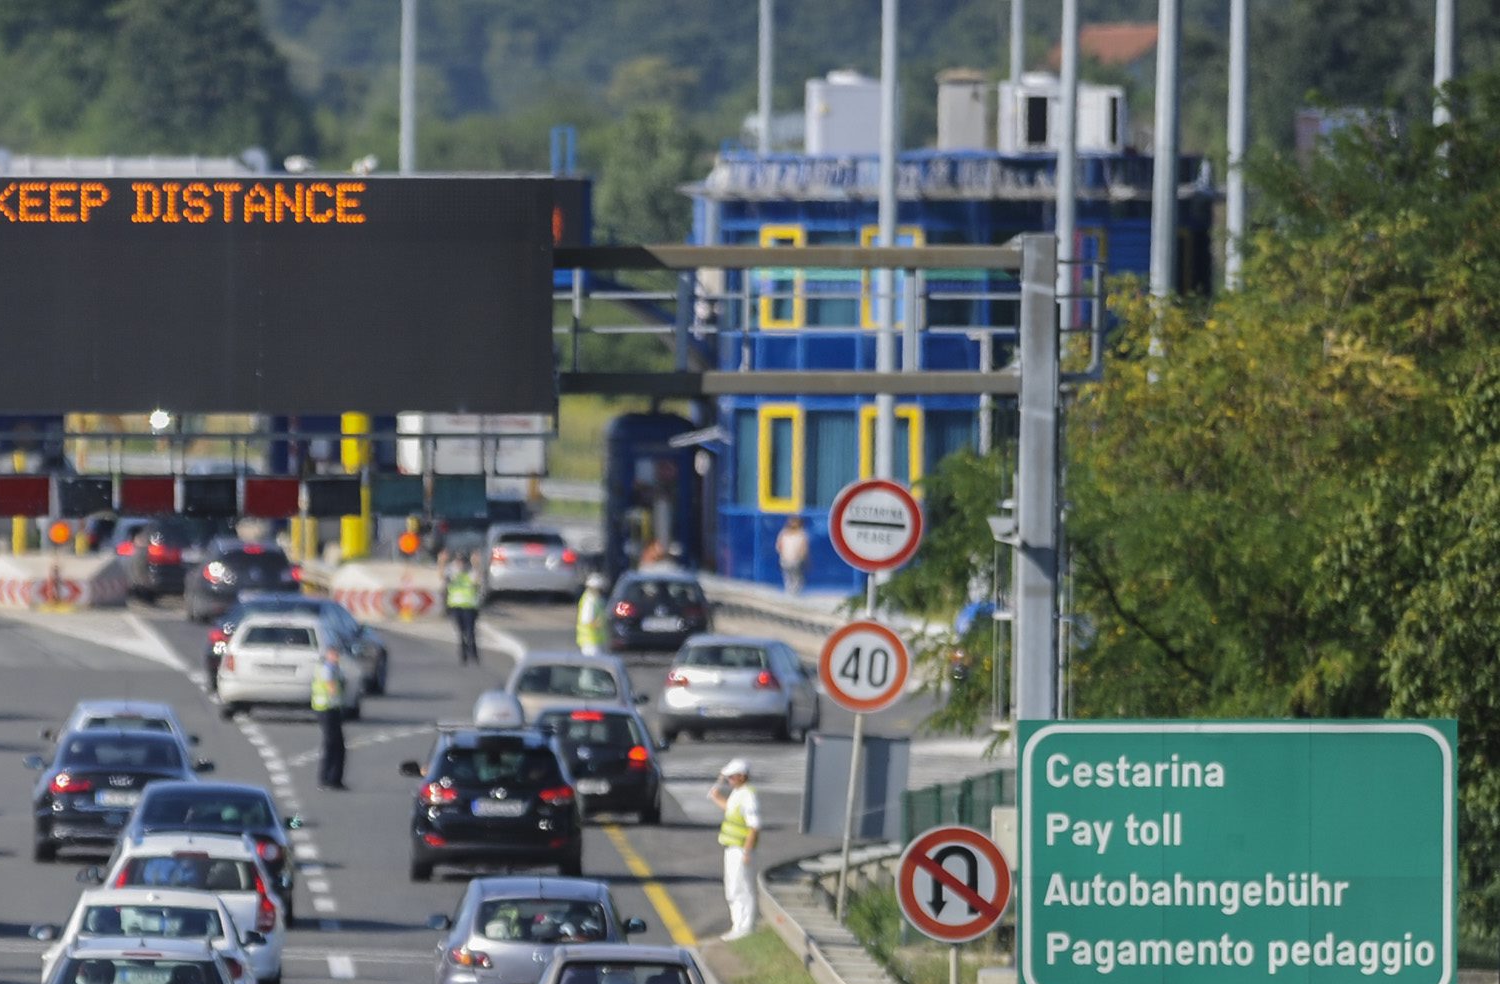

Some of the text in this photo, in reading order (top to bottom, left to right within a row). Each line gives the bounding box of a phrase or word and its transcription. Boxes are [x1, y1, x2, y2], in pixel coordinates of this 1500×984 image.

[131, 182, 367, 223] DISTANCE
[840, 647, 889, 687] 40
[1045, 753, 1226, 788] Cestarina
[1045, 812, 1182, 854] Pay toll
[1043, 872, 1349, 915] Autobahngebühr
[1045, 932, 1436, 975] Pagamento pedaggio
